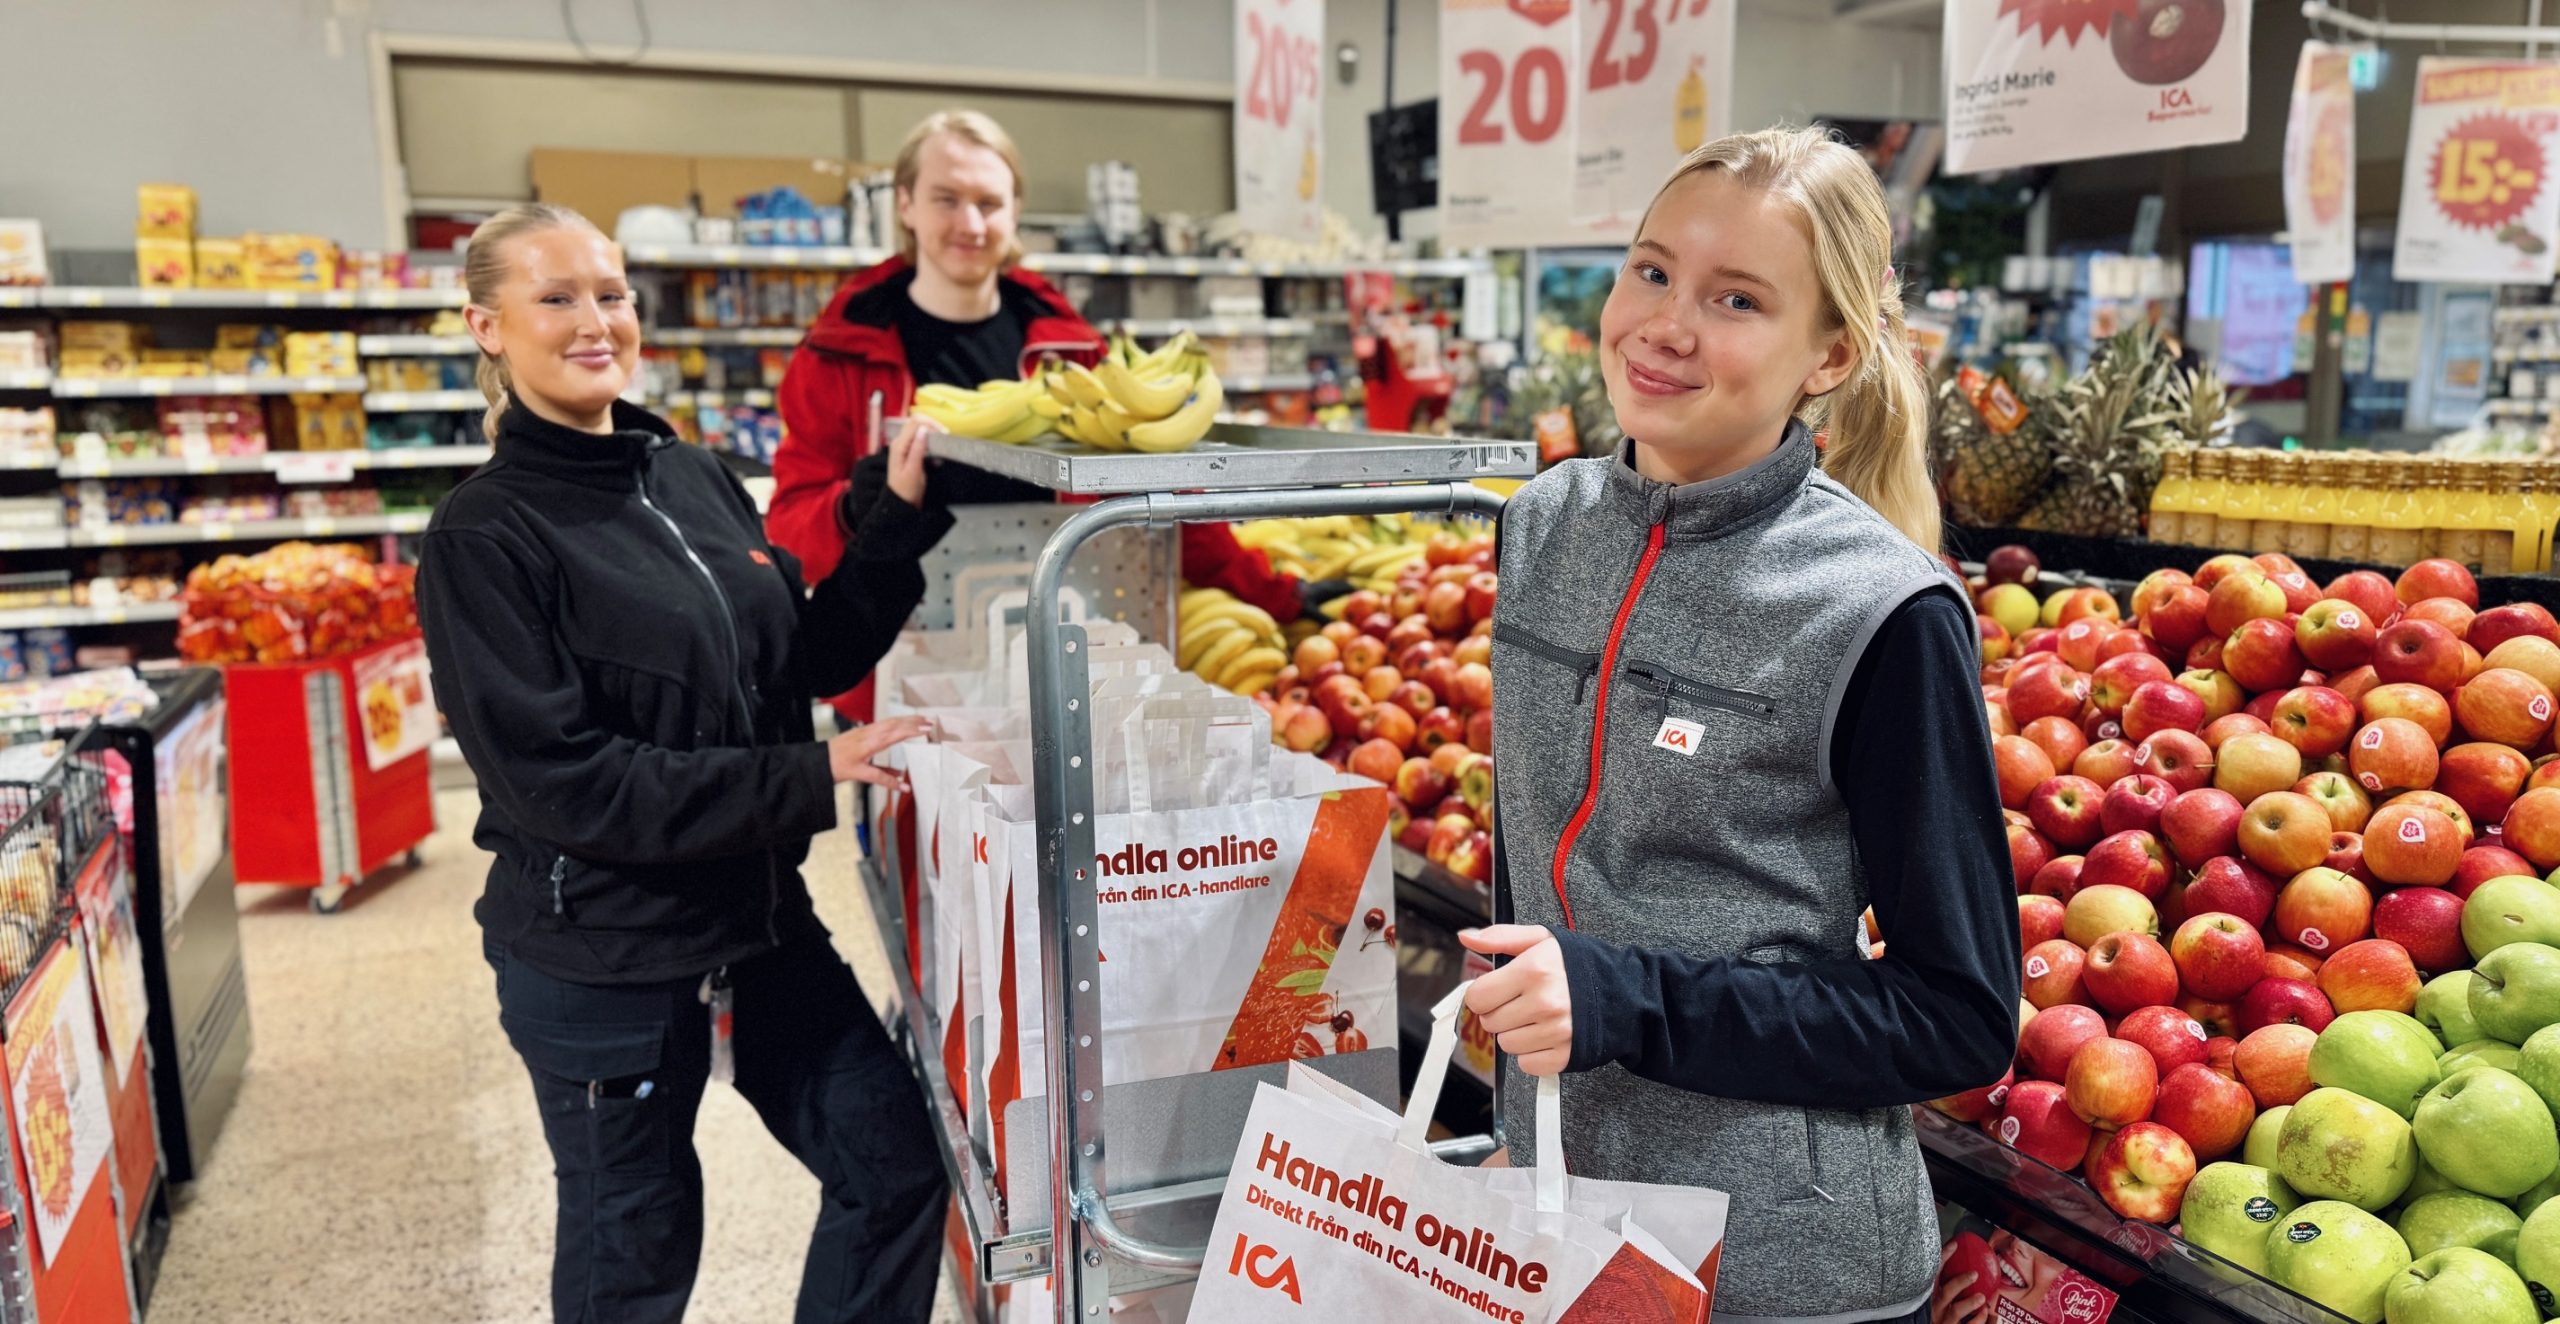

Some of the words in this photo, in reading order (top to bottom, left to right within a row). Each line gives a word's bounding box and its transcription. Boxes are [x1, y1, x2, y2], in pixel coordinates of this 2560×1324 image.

[2003, 67, 2055, 92] Marie
[1457, 46, 1567, 146] 20
[2161, 88, 2193, 109] ICA
[2438, 138, 2536, 205] 15:-
[1662, 728, 1687, 749] ICA
[1095, 843, 1168, 877] ndla
[1177, 834, 1278, 872] online
[1131, 885, 1158, 902] din
[1162, 875, 1270, 900] ICA-handlare
[1256, 1131, 1408, 1232] Handla
[1415, 1213, 1548, 1294] online
[1246, 1183, 1303, 1225] Direkt
[1306, 1210, 1349, 1242] från
[1353, 1230, 1383, 1258] din
[1386, 1244, 1524, 1324] ICA-handlare
[1228, 1232, 1302, 1305] ICA
[2000, 1298, 2016, 1312] Från
[2016, 1308, 2026, 1318] 29
[2064, 1290, 2097, 1307] Pink
[2064, 1304, 2095, 1322] Lady
